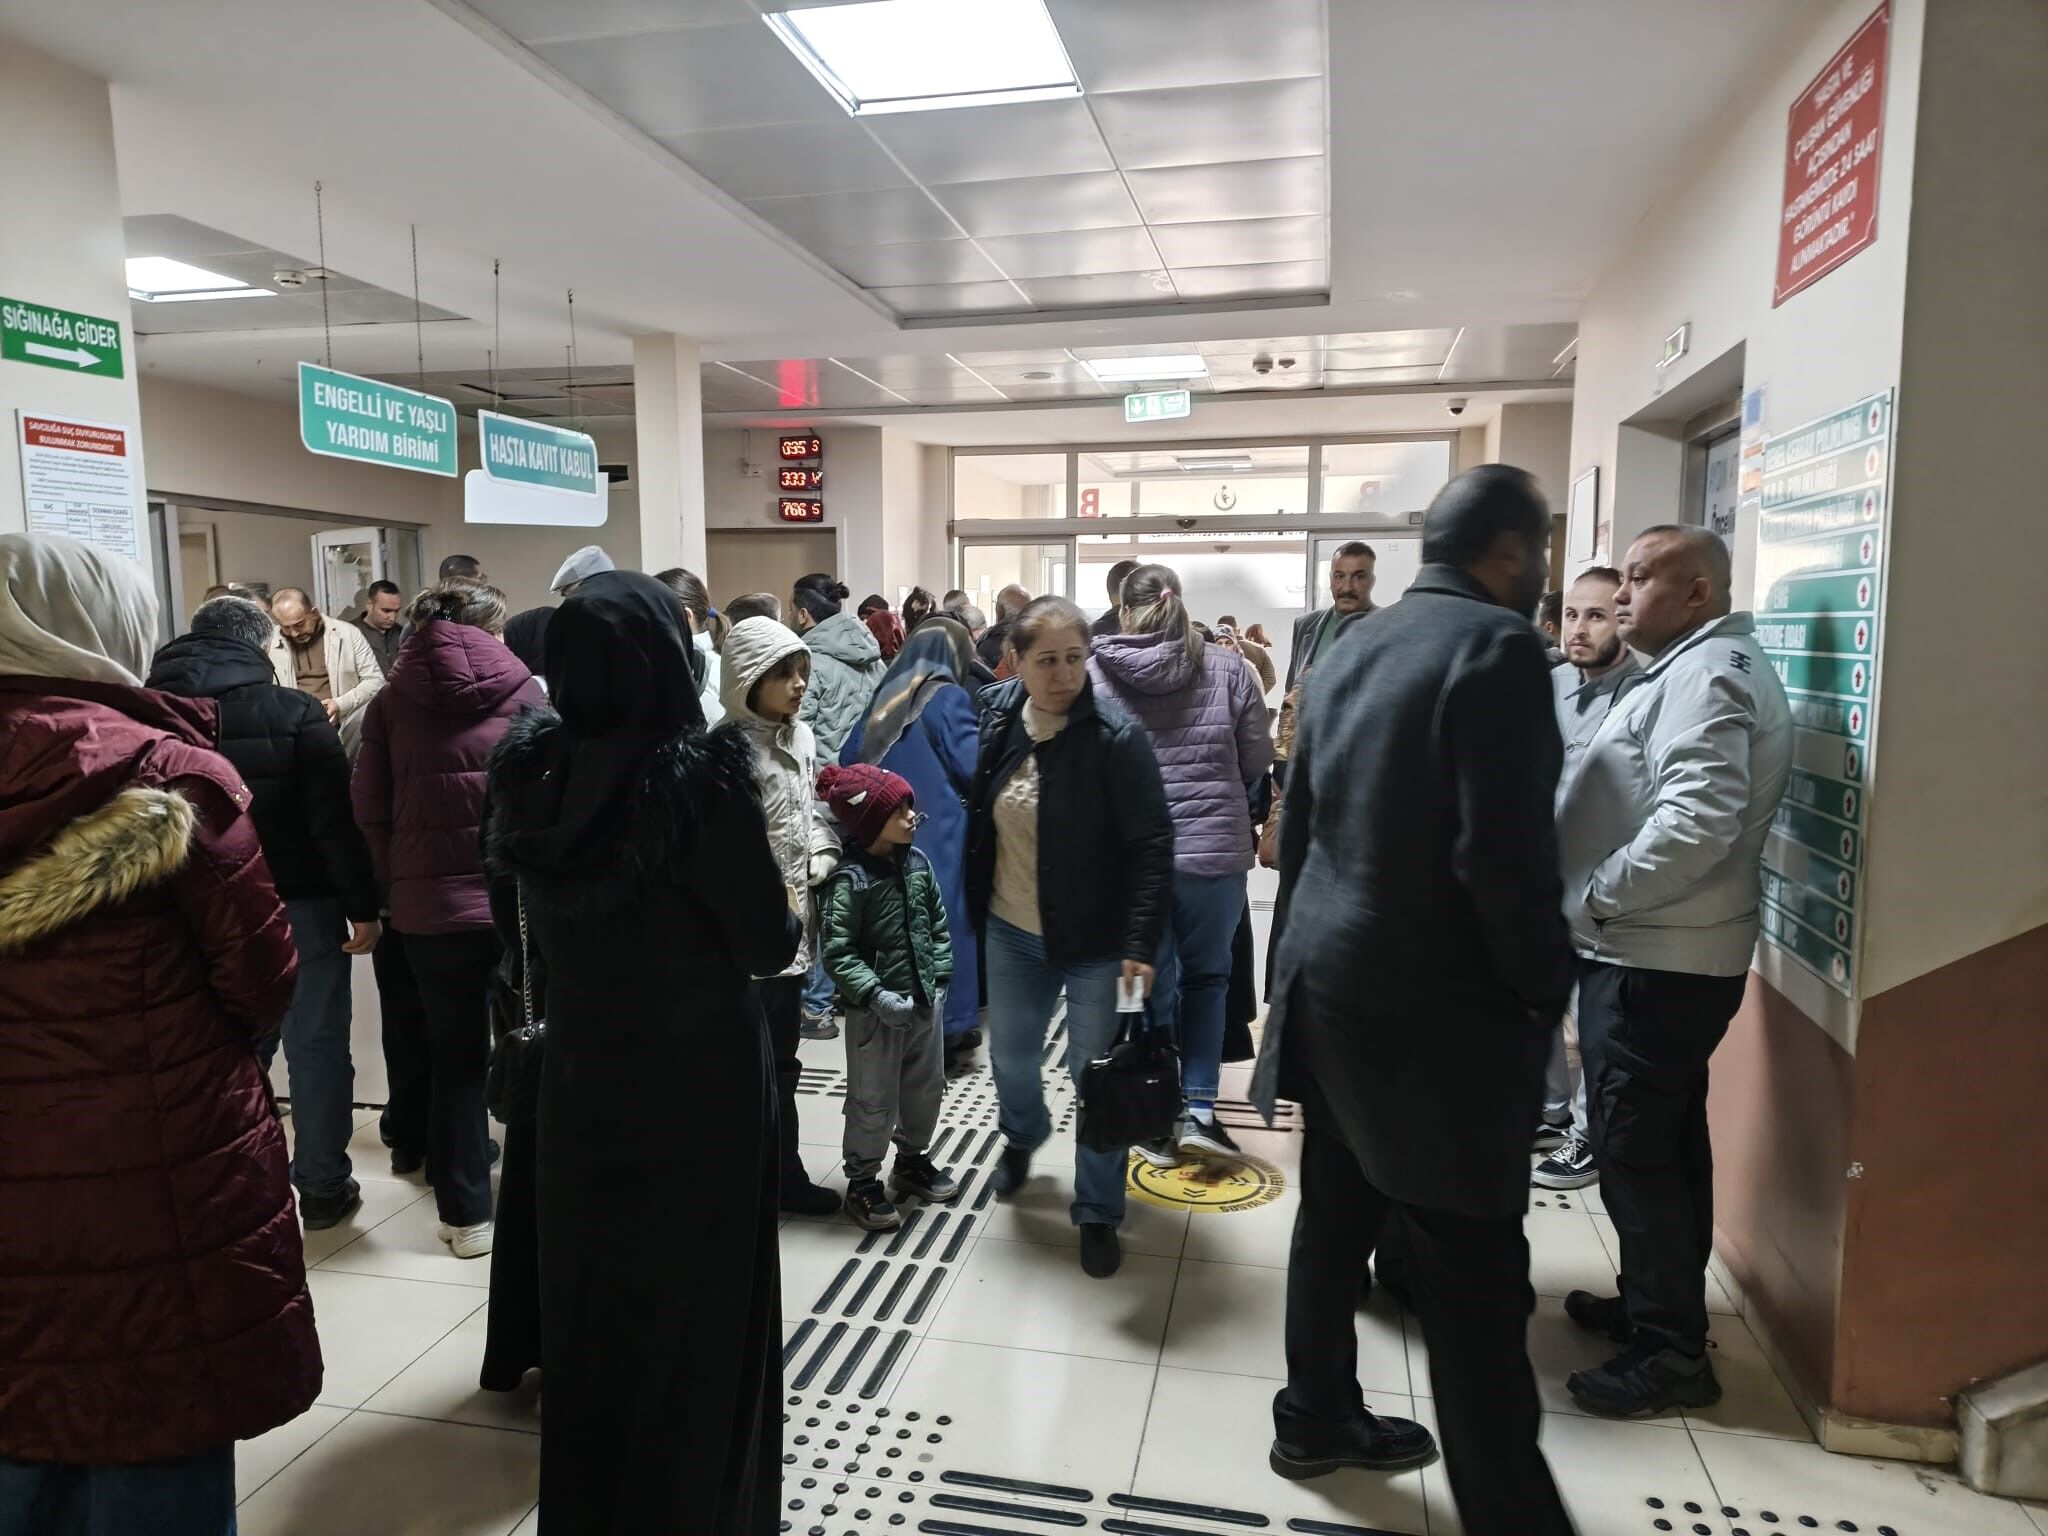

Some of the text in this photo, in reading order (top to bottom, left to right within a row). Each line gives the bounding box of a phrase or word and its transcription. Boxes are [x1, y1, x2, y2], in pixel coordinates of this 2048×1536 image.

[2, 303, 118, 349] SIĞINAĞA GİDER
[314, 382, 446, 433] ENGELLİ VE YAŞLI
[326, 420, 439, 463] YARDIM BİRİMİ
[490, 433, 593, 480] HASTA KAYIT KABUL
[782, 471, 807, 486] 333
[811, 503, 821, 515] 5
